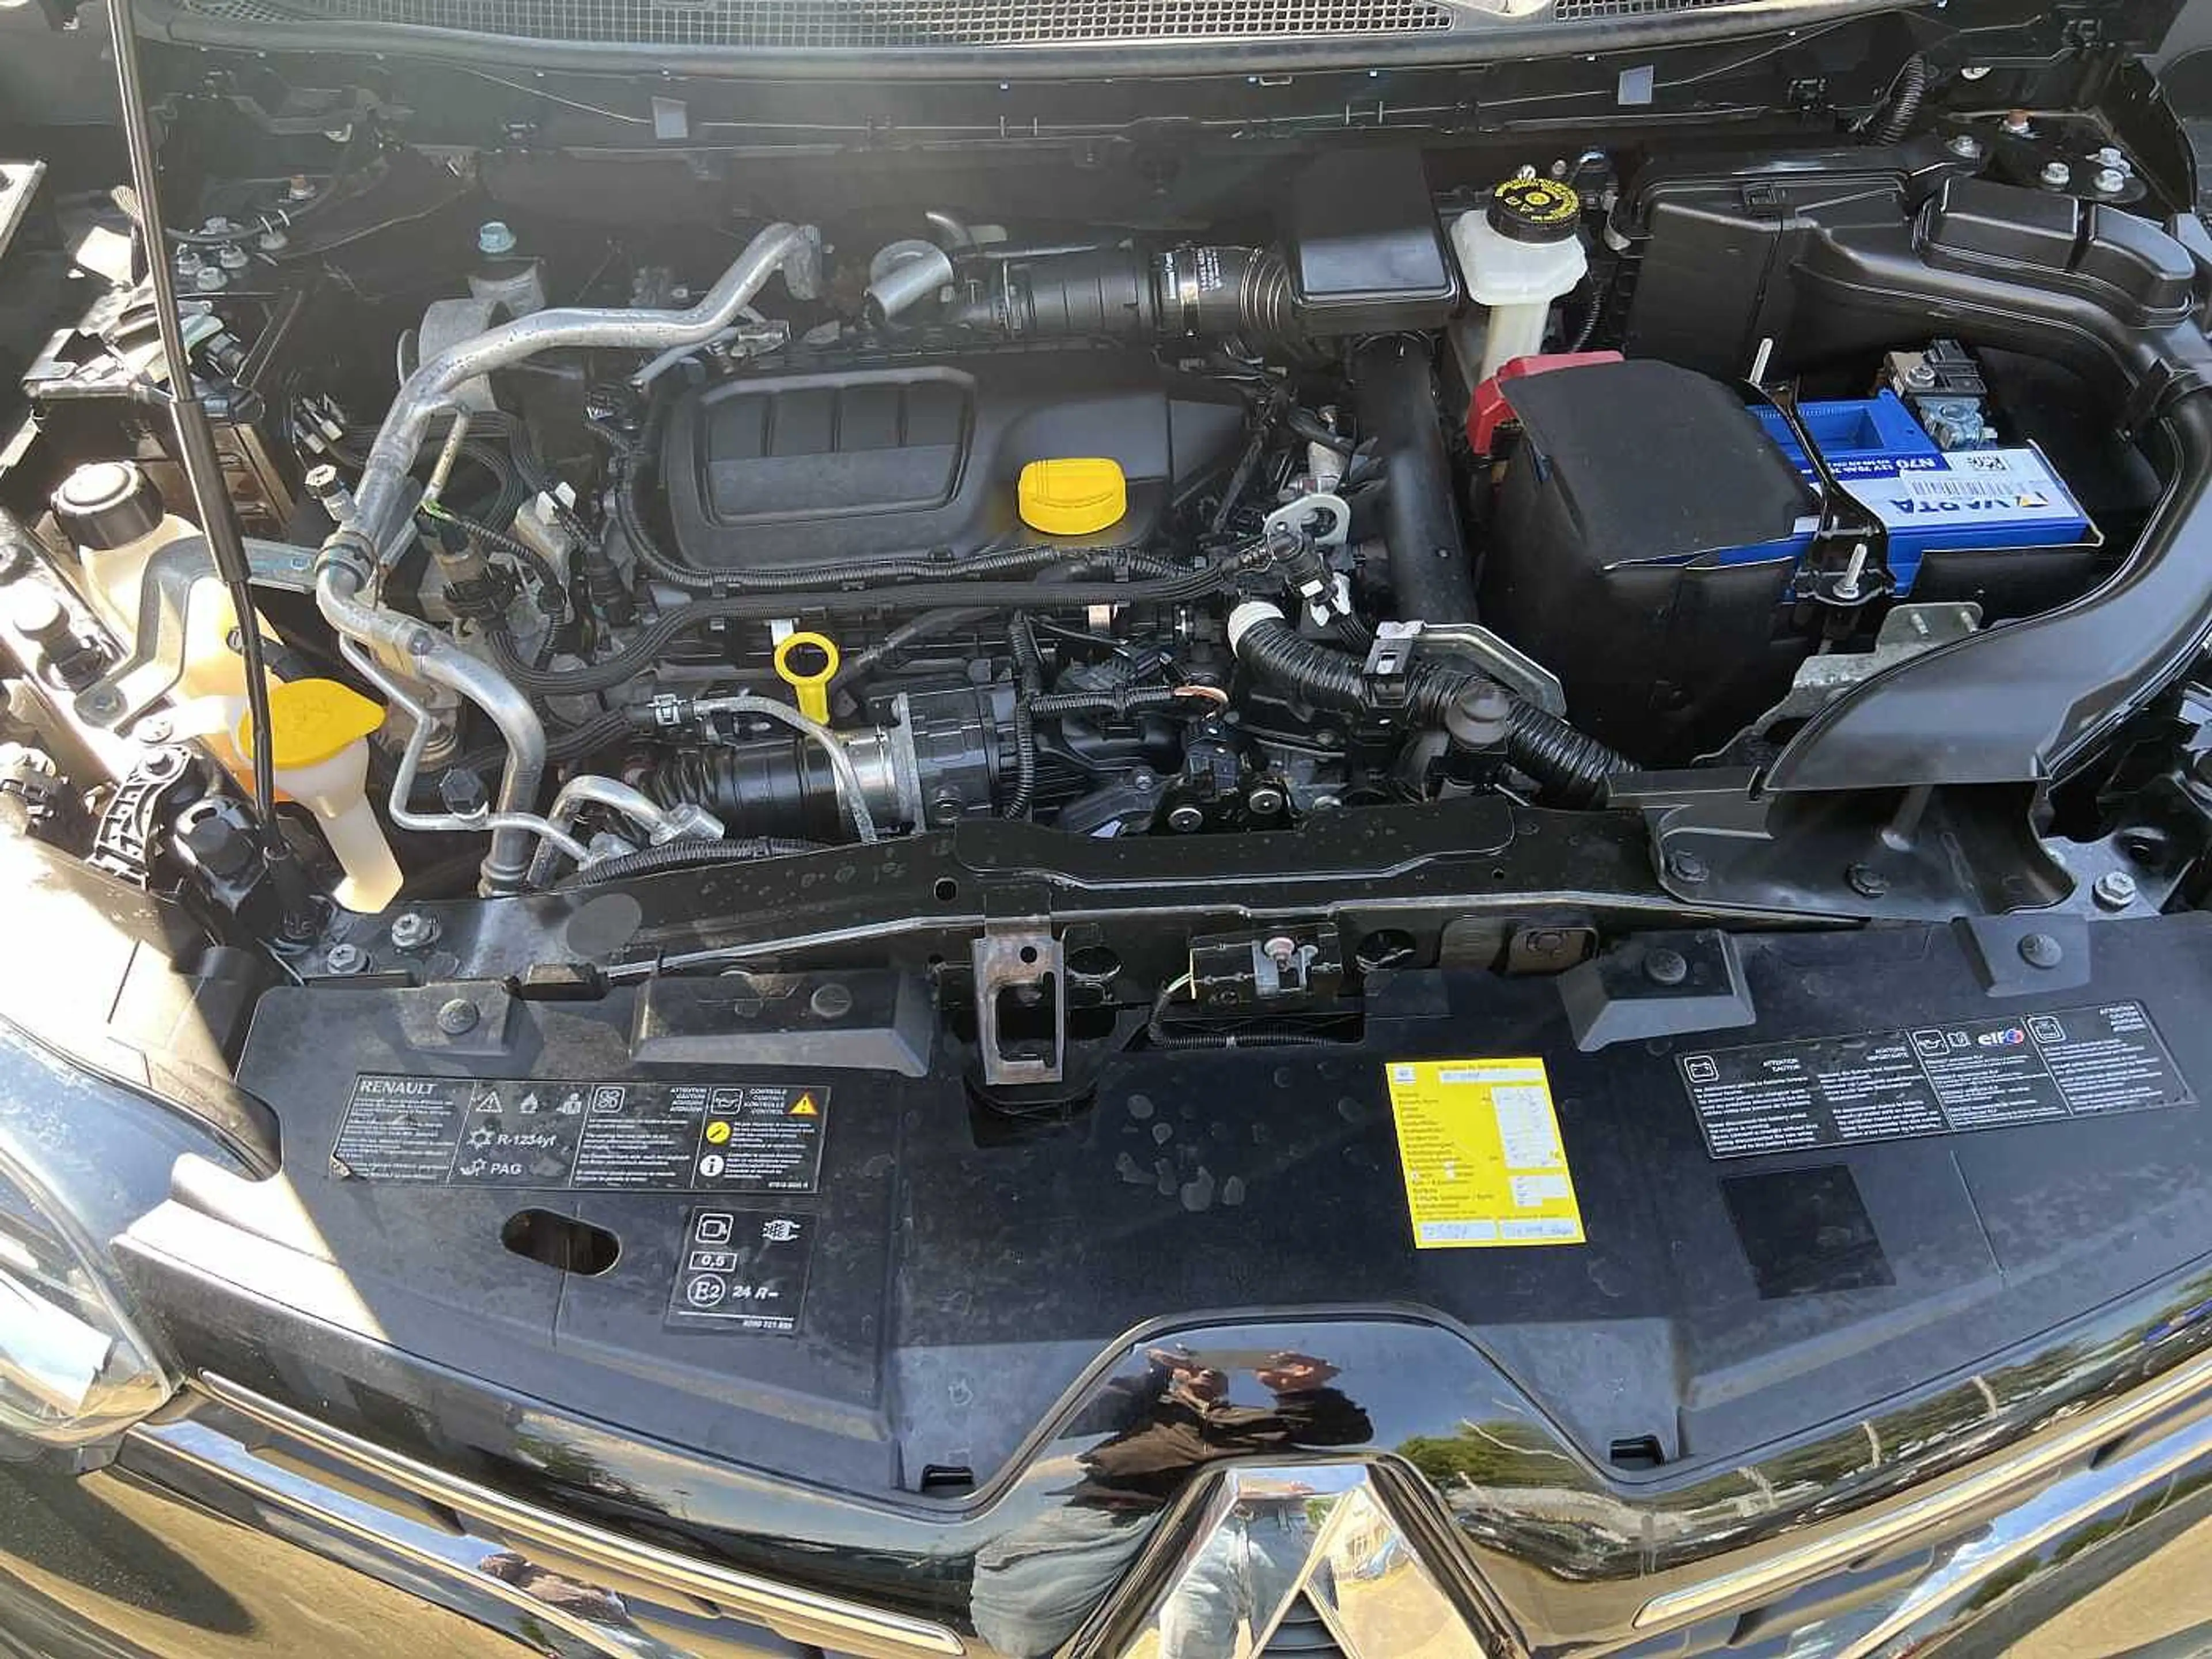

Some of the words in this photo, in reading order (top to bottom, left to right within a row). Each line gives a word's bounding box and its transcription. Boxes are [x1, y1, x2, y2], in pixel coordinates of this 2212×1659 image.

[1896, 457, 1936, 471] N70
[1889, 499, 2010, 514] VARTA
[1978, 1032, 2003, 1046] elf
[361, 1081, 438, 1094] RENAULT
[497, 1134, 557, 1148] R-1234yf
[490, 1163, 522, 1175] PAG
[701, 1255, 725, 1267] 0,5
[732, 1285, 751, 1297] 24
